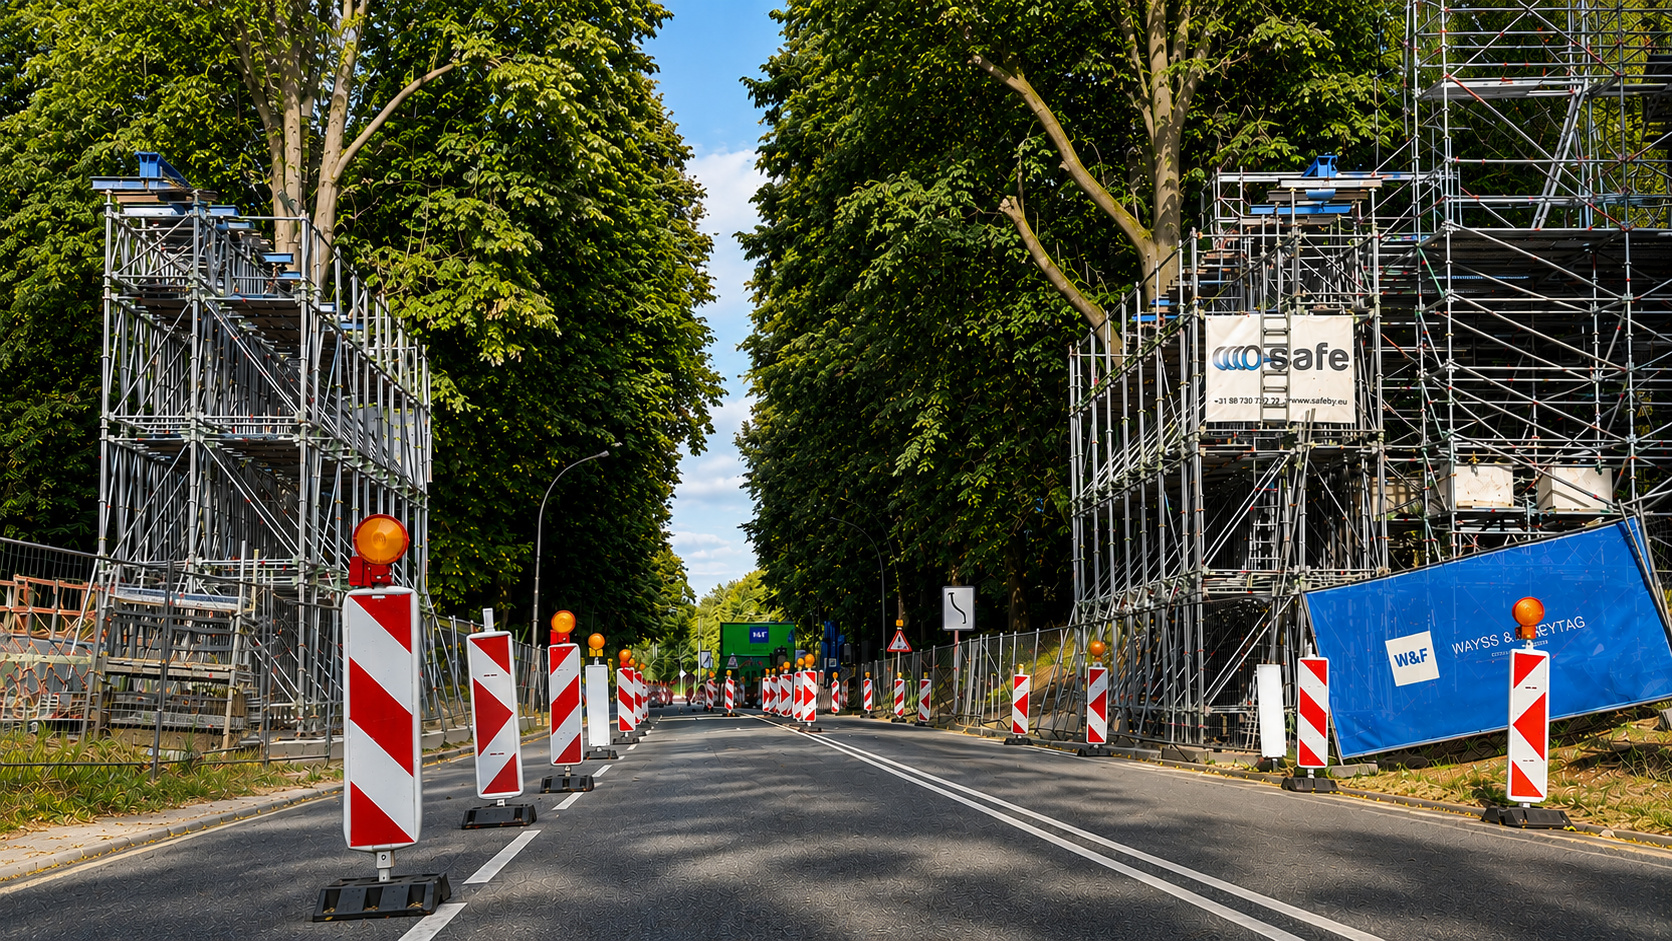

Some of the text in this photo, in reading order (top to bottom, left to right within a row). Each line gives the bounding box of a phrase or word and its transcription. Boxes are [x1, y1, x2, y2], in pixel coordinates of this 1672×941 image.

[1269, 342, 1349, 371] safe
[1239, 397, 1253, 405] 730
[1451, 615, 1586, 655] WAYSS & EYTAG
[1393, 647, 1427, 667] W&F
